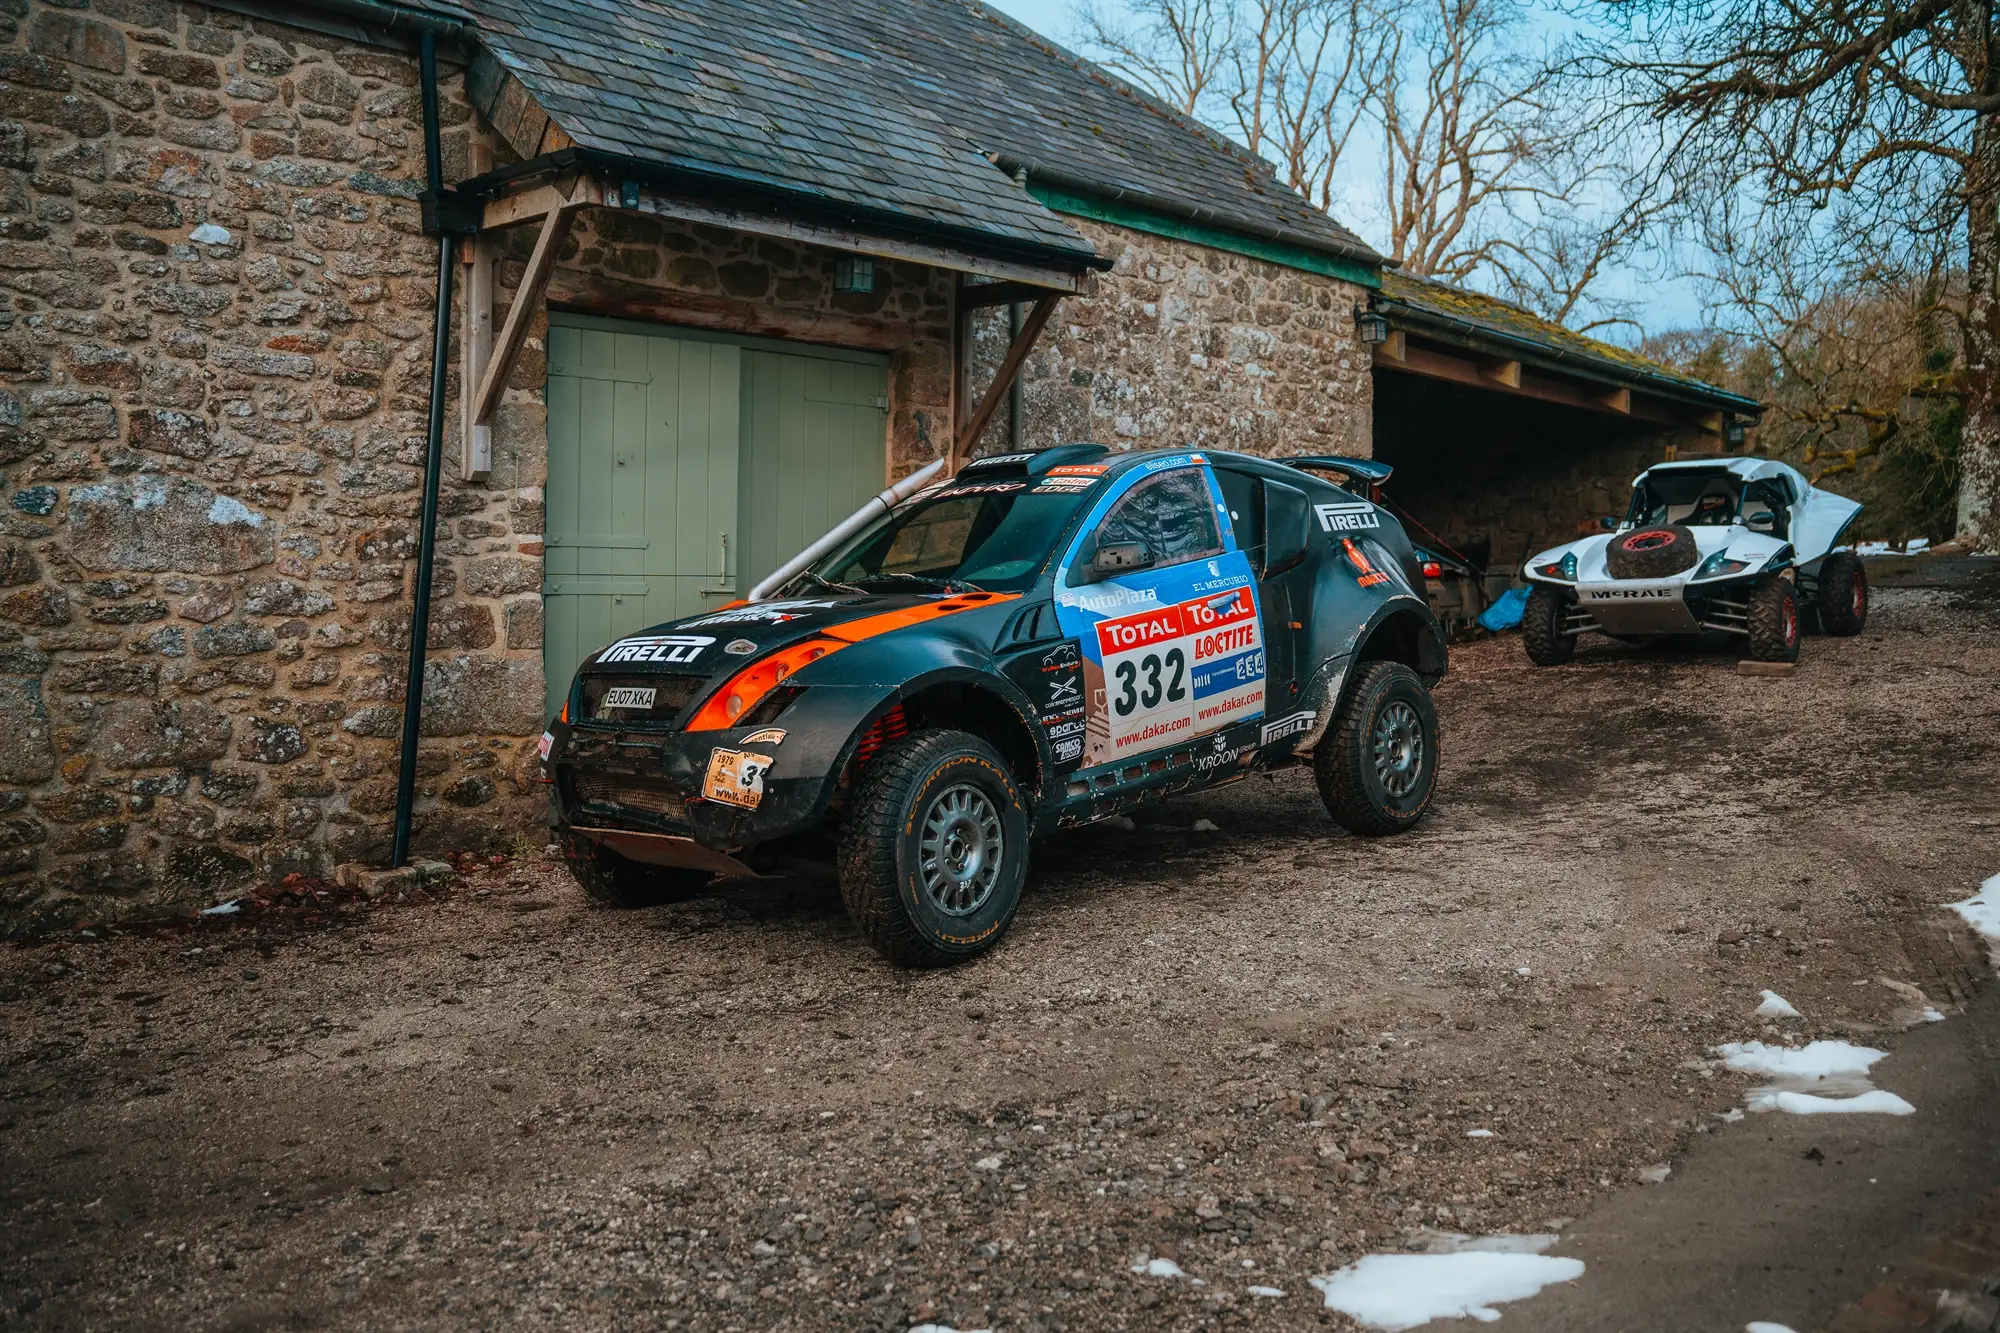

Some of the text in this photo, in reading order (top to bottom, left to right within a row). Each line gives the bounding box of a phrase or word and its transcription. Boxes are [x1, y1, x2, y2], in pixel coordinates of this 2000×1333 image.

[1031, 485, 1088, 493] EDGE
[1313, 502, 1380, 532] PIRELLI
[1193, 575, 1249, 593] EL MERCURIO
[1079, 588, 1157, 613] AutoPlaza
[1187, 598, 1249, 626] TOAL
[1106, 618, 1177, 647] TOTAL
[1195, 624, 1254, 660] LOCTITE
[595, 635, 717, 663] PIRELLI
[1114, 648, 1186, 717] 332
[607, 690, 653, 705] EU07 XKA
[1198, 690, 1263, 720] www.dakar.com
[1116, 716, 1191, 748] www.dakar.com
[1260, 710, 1317, 747] PIRELLI
[1055, 738, 1080, 753] SAMCO
[1198, 748, 1239, 771] KROON
[717, 755, 734, 765] 1979
